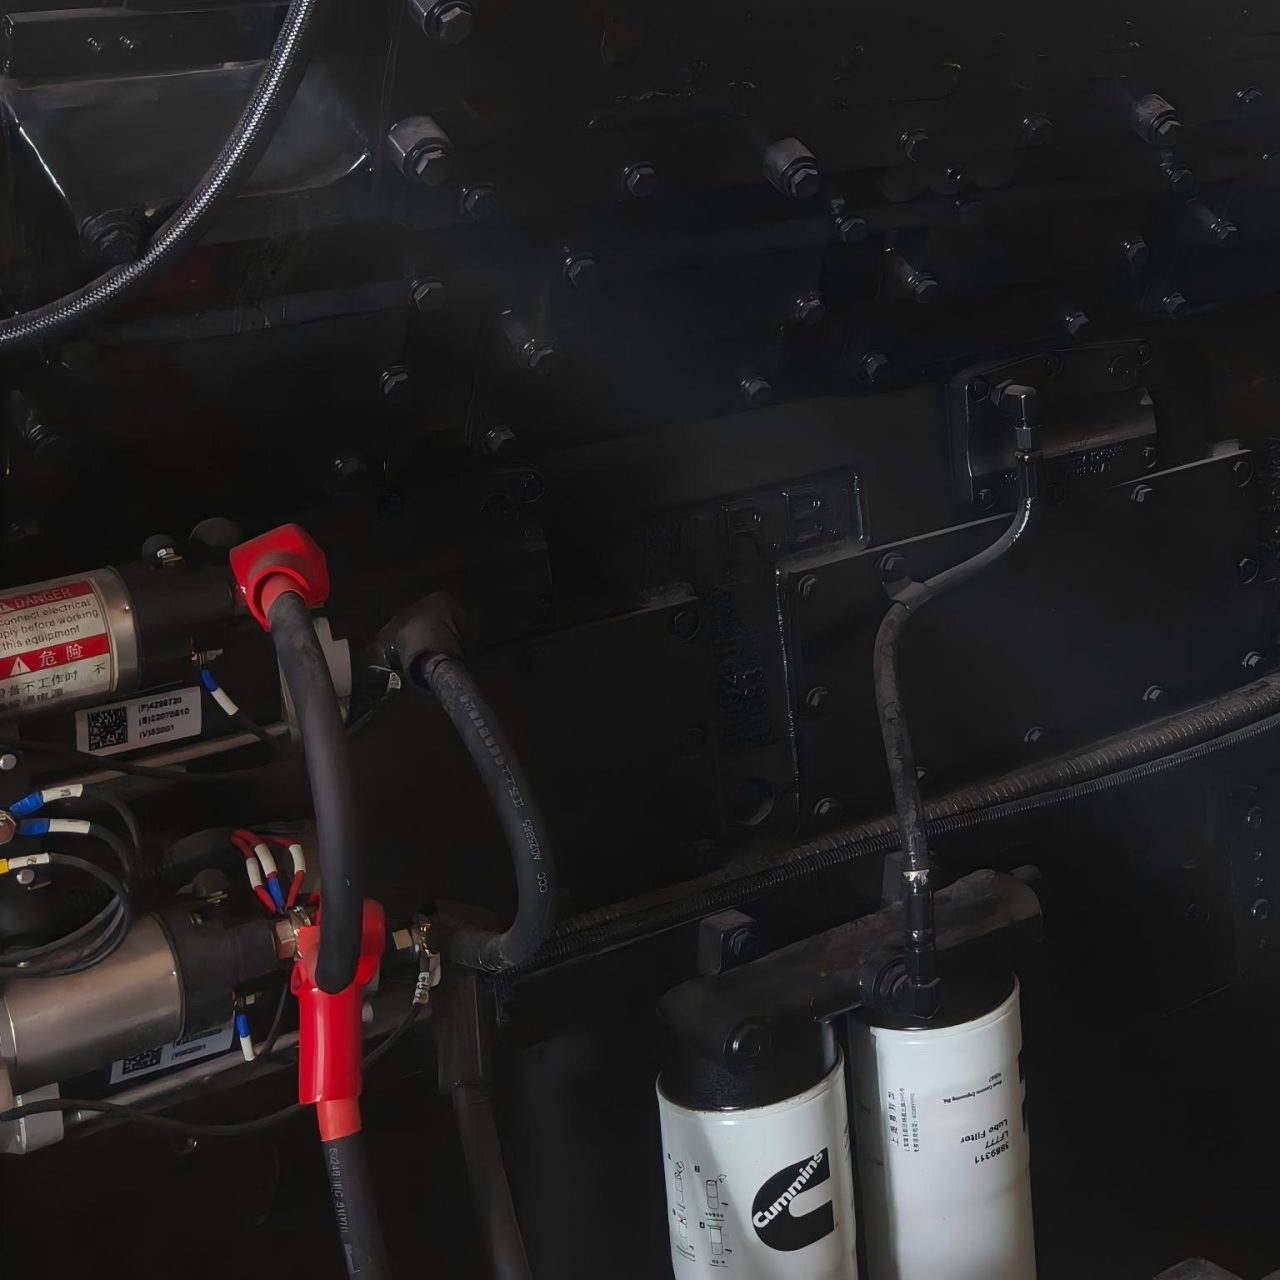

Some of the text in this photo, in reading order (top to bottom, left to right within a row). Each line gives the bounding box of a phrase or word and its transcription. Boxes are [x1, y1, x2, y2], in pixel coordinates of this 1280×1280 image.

[14, 587, 73, 609] DANGER
[43, 599, 92, 616] electrical
[21, 620, 56, 634] before
[60, 608, 99, 625] working
[2, 624, 81, 652] this equipment
[39, 643, 84, 668] 危险
[752, 1150, 825, 1228] Cummins
